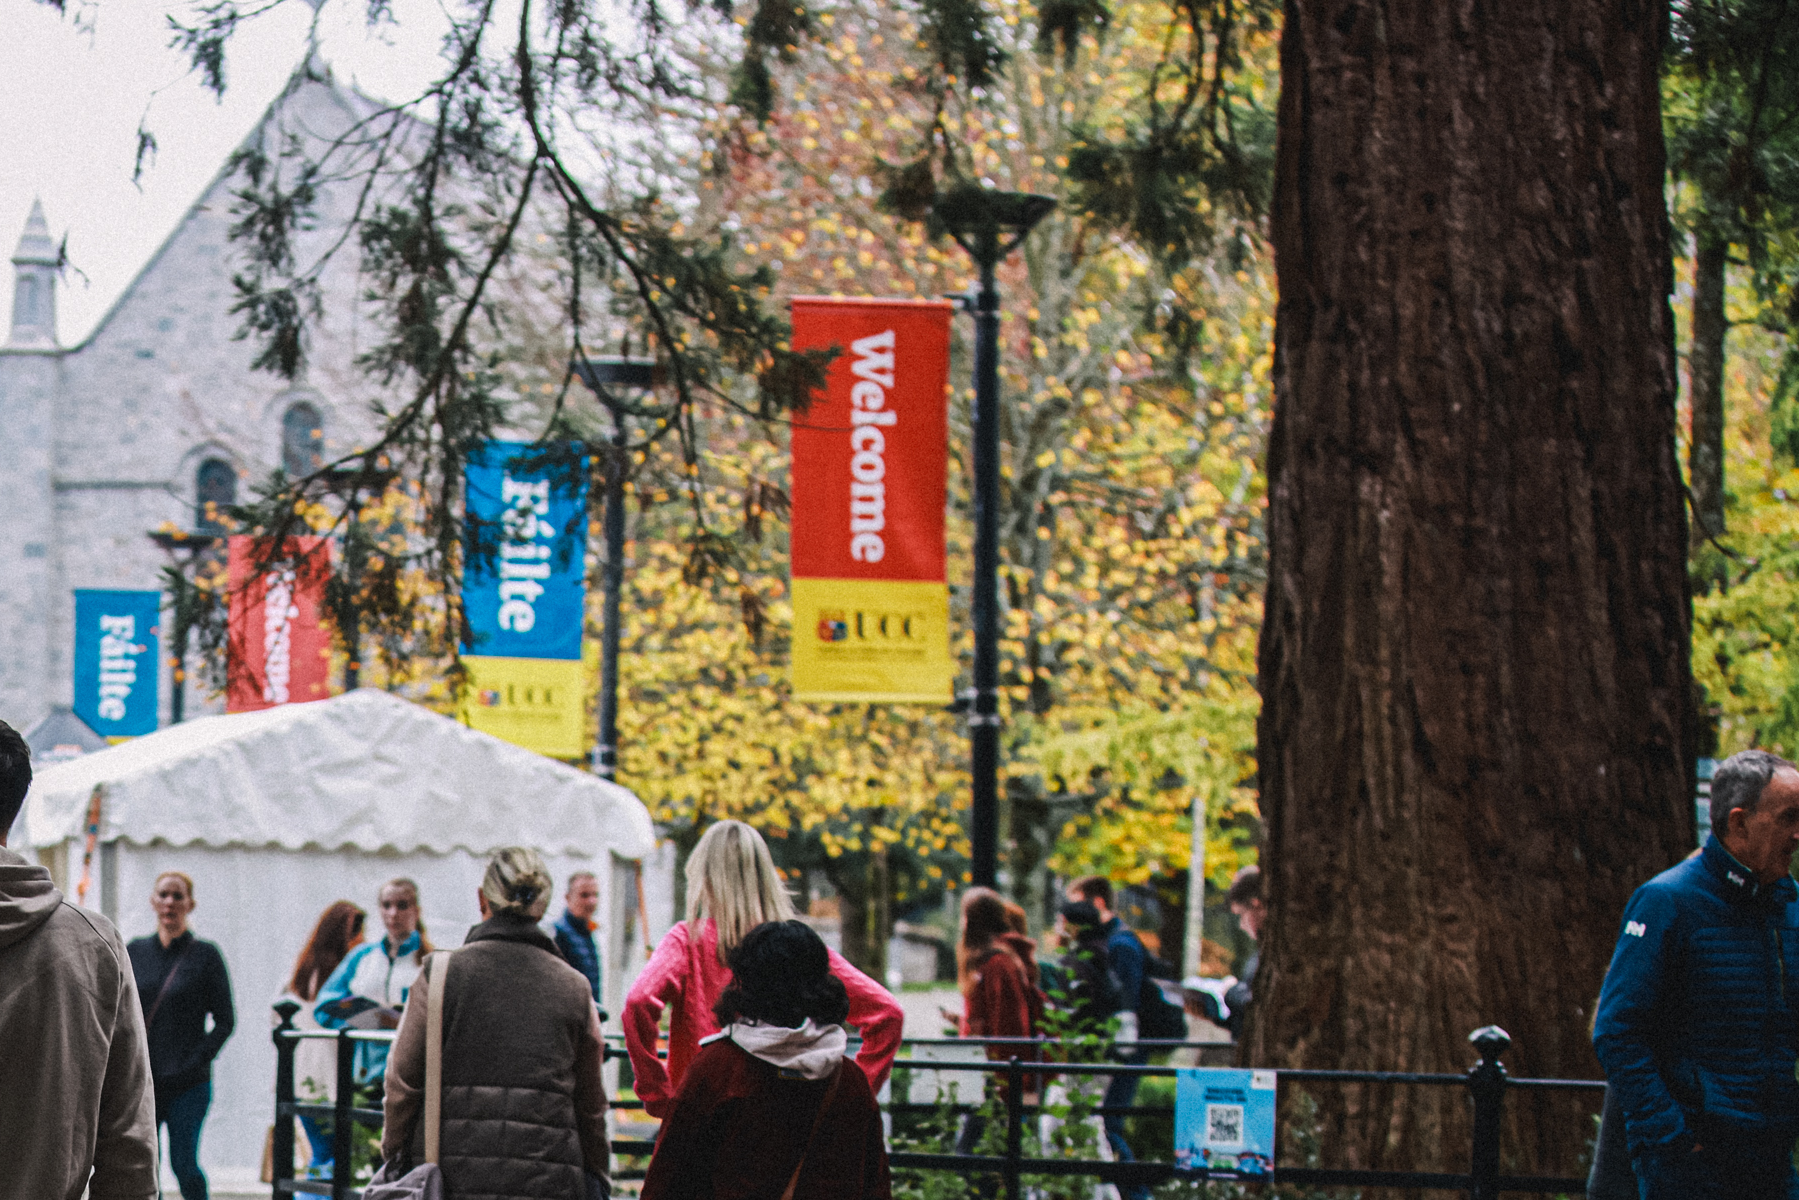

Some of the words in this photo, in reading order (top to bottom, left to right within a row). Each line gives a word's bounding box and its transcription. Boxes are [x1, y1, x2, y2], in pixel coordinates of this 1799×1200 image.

[851, 329, 898, 563] Welcome
[498, 477, 556, 633] Fáilte
[98, 614, 140, 721] Fáilte
